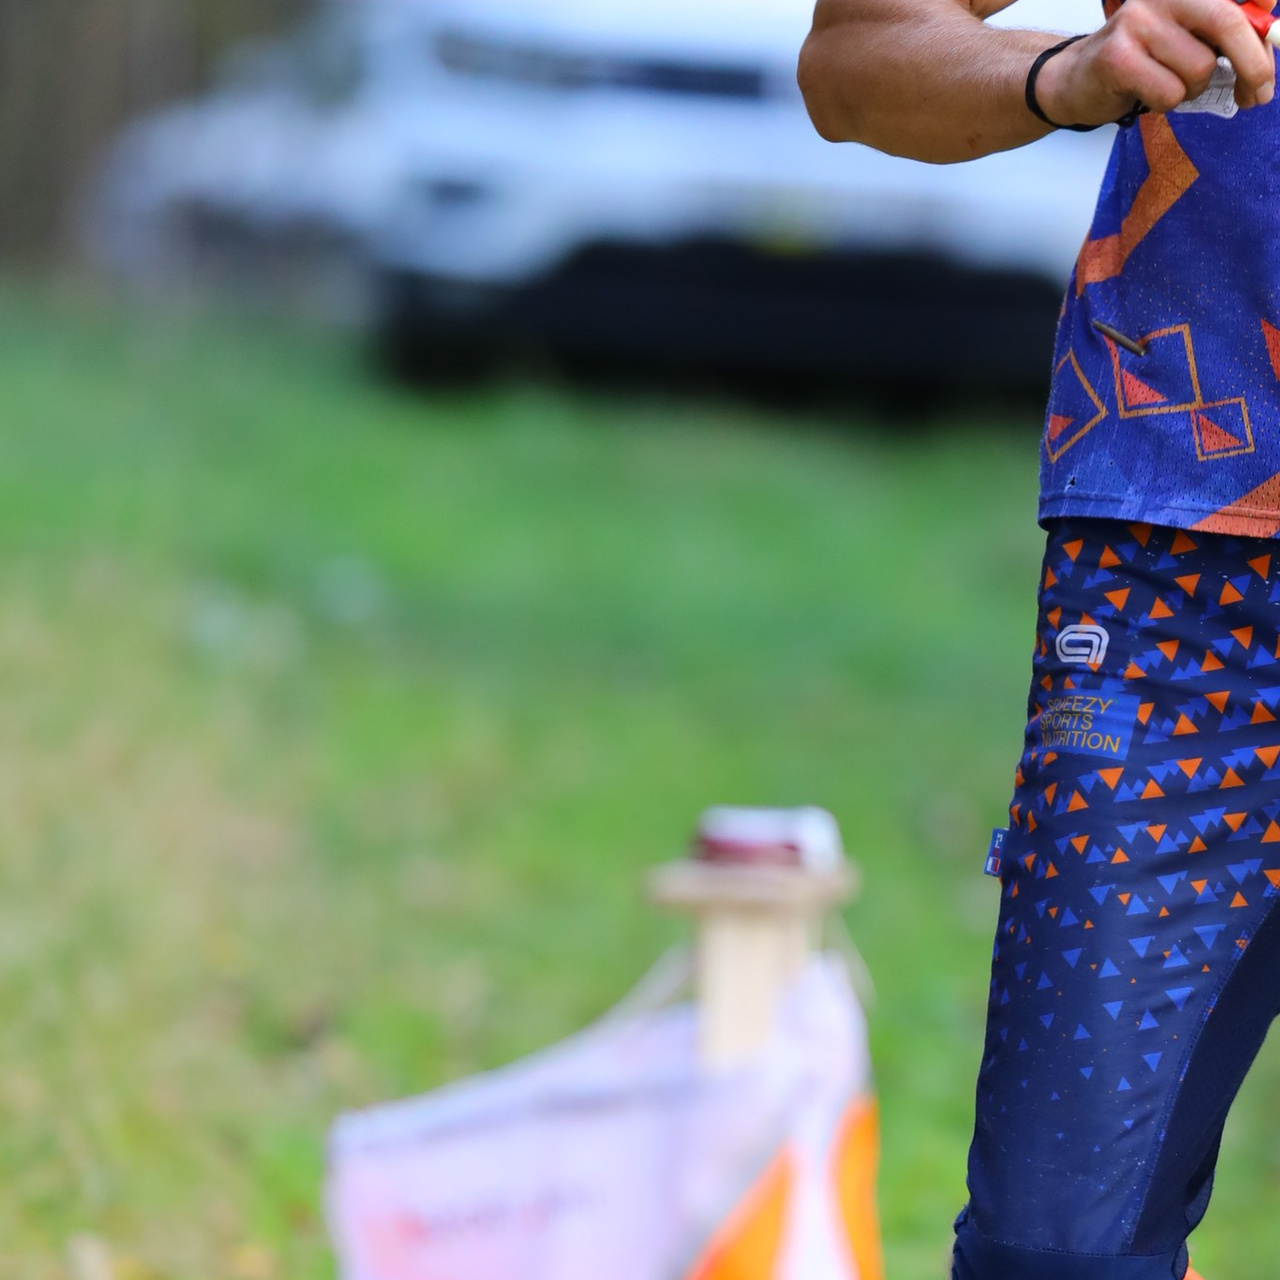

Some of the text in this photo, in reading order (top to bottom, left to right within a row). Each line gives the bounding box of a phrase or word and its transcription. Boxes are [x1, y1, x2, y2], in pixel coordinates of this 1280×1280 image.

[1047, 696, 1113, 714] SQUEEZY
[1040, 713, 1093, 730] SPORTS
[1041, 731, 1120, 753] NUTRITION
